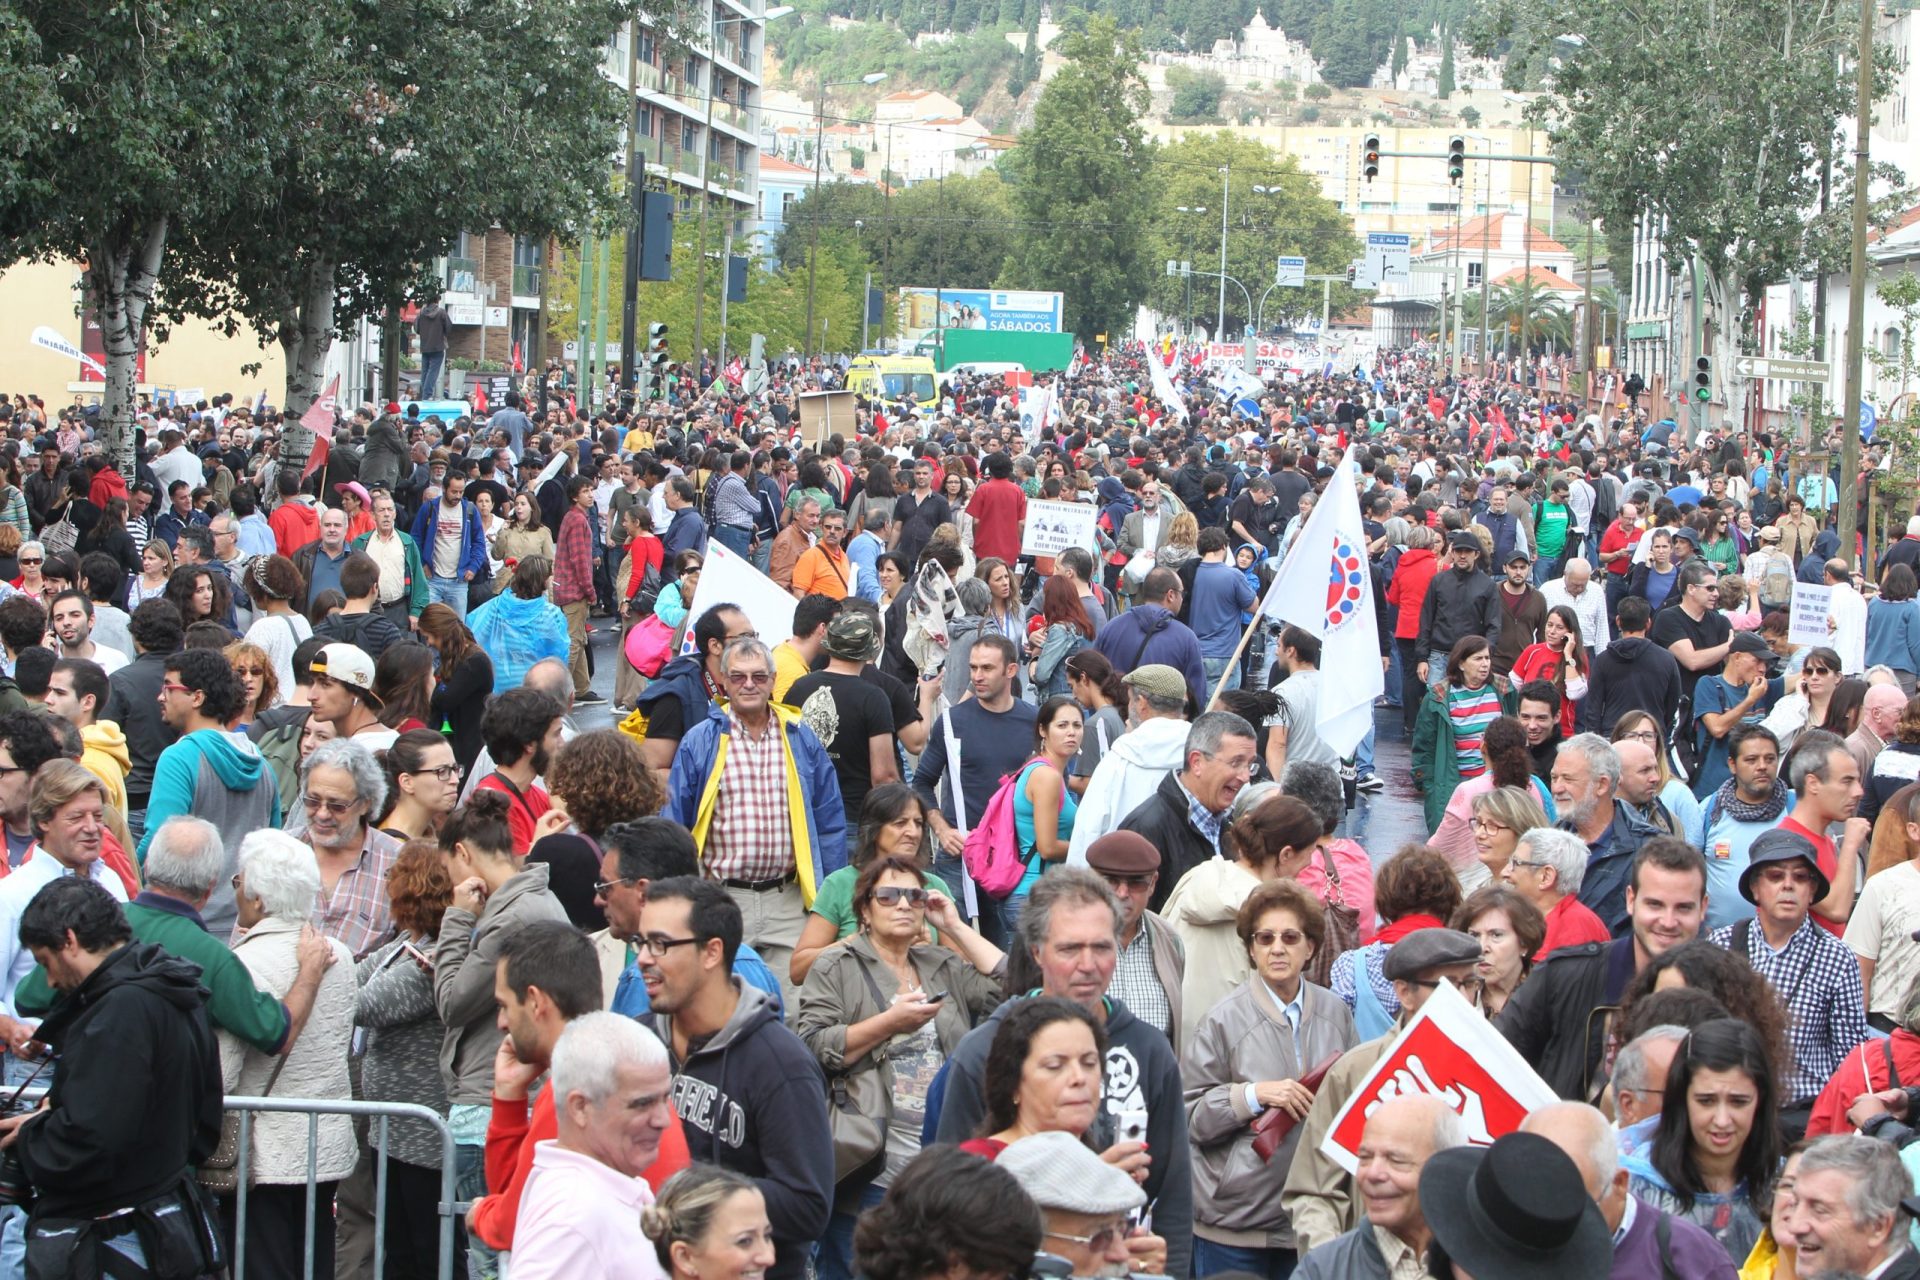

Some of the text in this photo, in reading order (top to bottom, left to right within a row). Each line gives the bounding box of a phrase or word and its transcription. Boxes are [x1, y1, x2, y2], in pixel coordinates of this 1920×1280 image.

[990, 319, 1051, 333] SÁBADOS
[1770, 364, 1795, 374] Museu
[1796, 367, 1805, 375] da
[1049, 535, 1067, 543] ROUBA
[1034, 541, 1050, 549] QUEM
